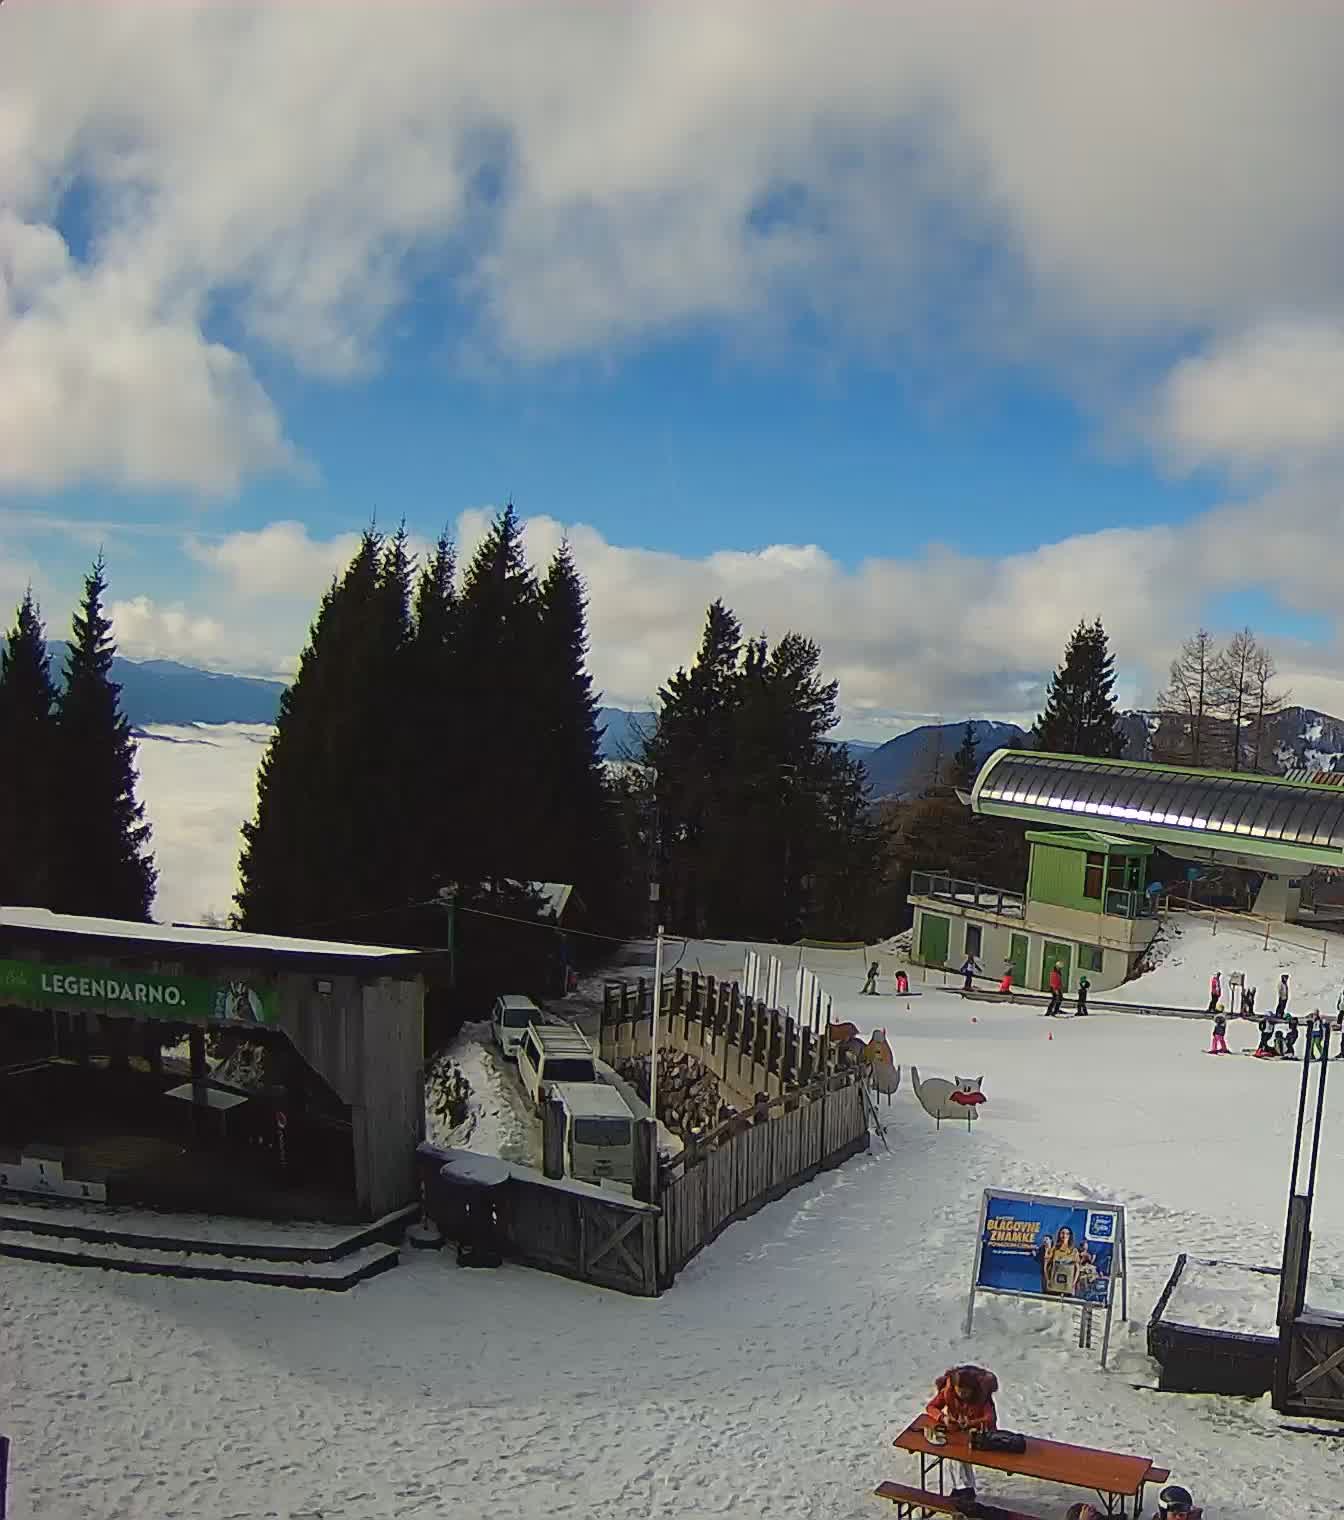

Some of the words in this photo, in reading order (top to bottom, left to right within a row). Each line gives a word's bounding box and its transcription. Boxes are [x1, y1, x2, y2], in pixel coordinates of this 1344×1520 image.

[41, 973, 187, 1006] LEGENDARNO.
[987, 1219, 1041, 1233] BLAGOVNE
[990, 1230, 1036, 1243] ZNAMKE
